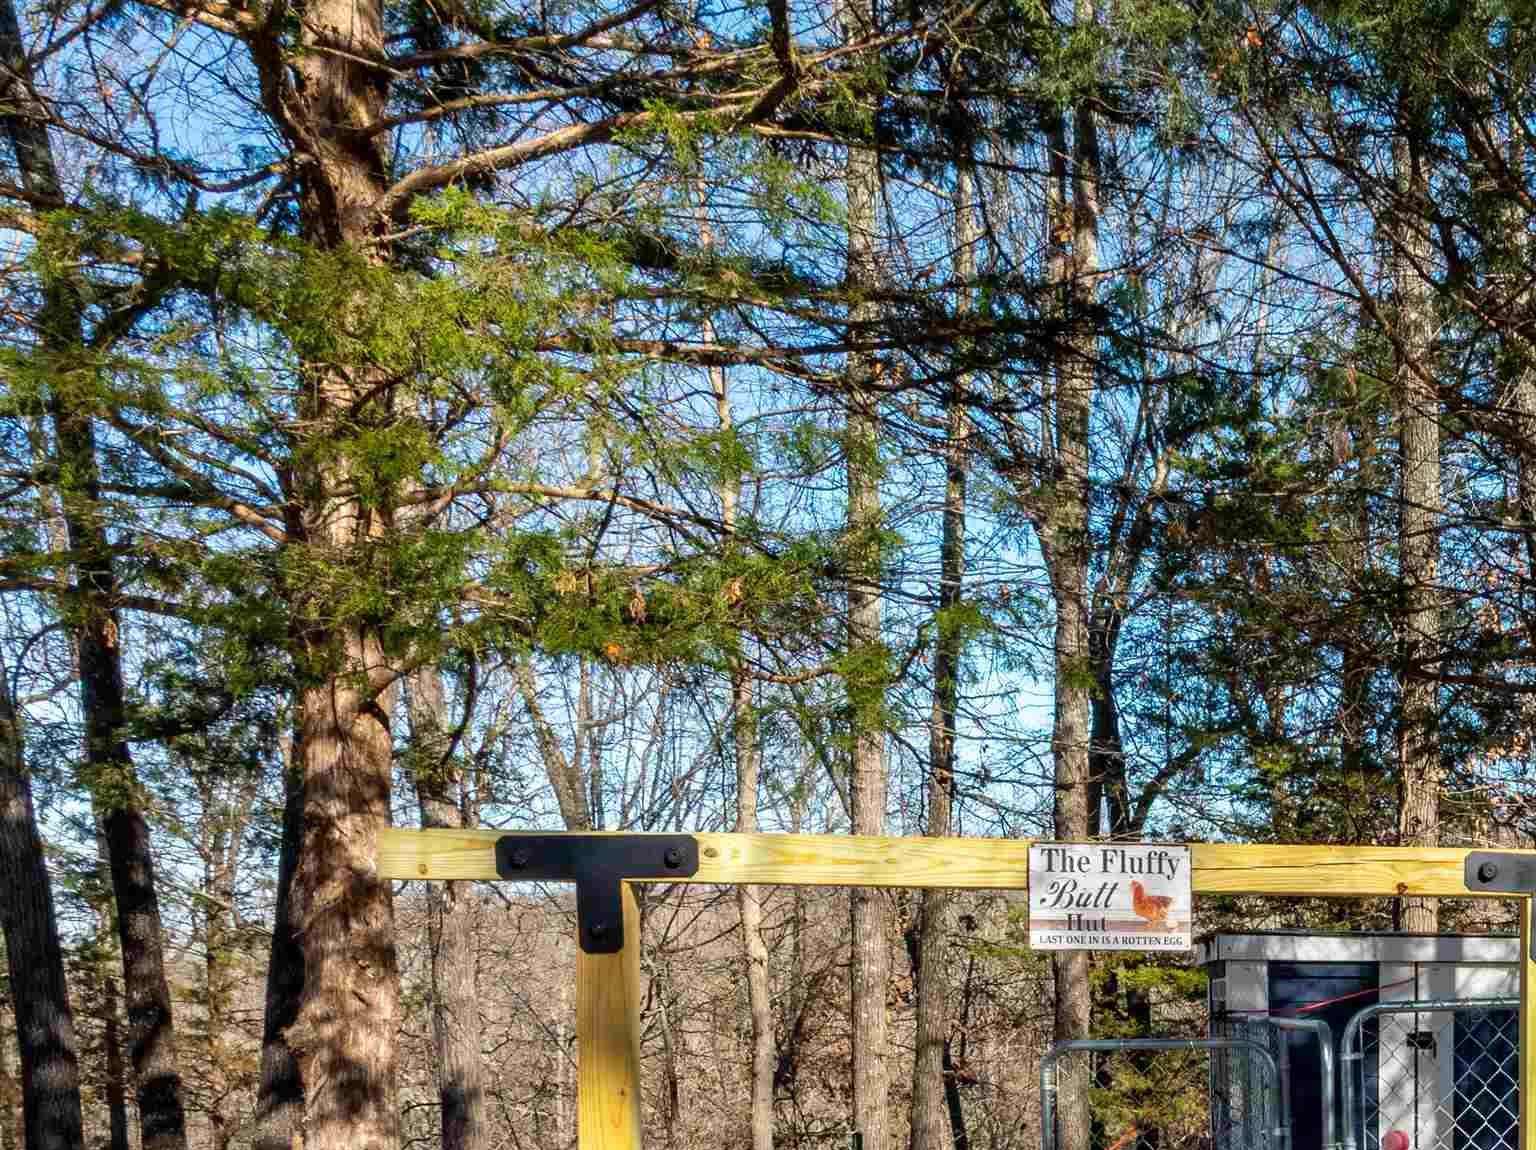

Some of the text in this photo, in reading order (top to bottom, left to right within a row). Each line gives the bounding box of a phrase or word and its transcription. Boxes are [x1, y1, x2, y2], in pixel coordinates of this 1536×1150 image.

[1040, 848, 1181, 880] The Fluffy
[1040, 878, 1119, 909] Butt
[1067, 913, 1106, 931] Hut
[1039, 935, 1184, 945] LAST ONE IN IS A ROTTEN EGG
